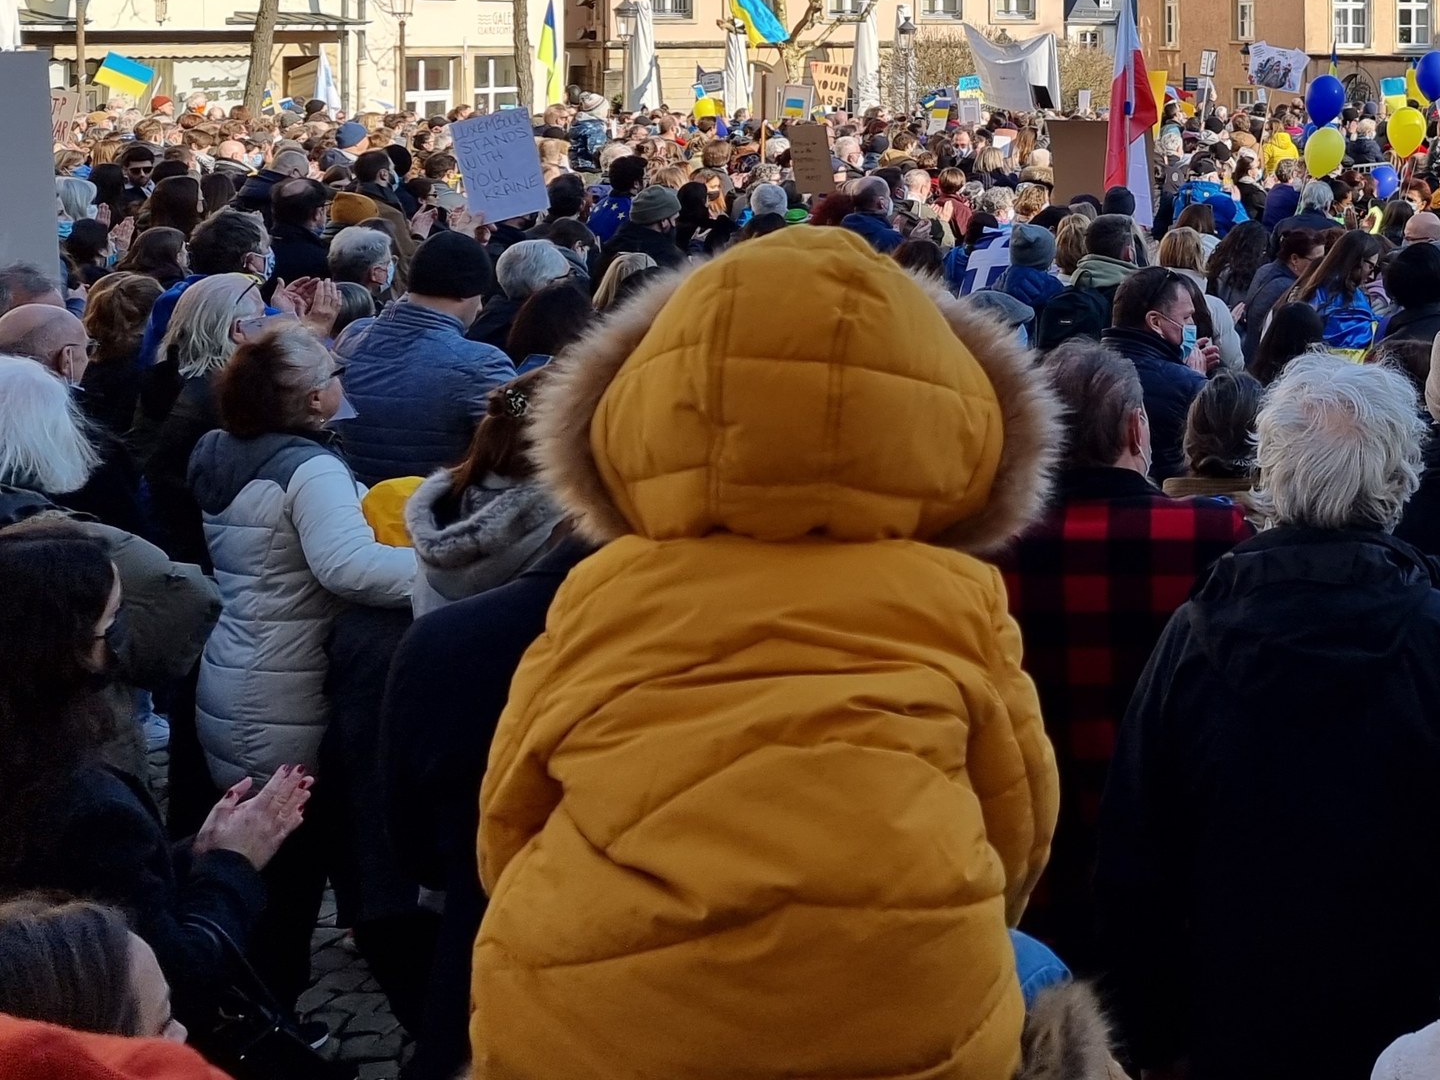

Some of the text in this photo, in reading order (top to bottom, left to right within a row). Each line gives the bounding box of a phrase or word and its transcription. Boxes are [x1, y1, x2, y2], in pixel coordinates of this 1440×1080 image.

[824, 64, 848, 77] WAR
[817, 79, 846, 92] YOUR
[460, 127, 529, 155] STANDS
[462, 150, 503, 171] WITH
[465, 167, 508, 191] YOU
[482, 173, 540, 199] KRAINE
